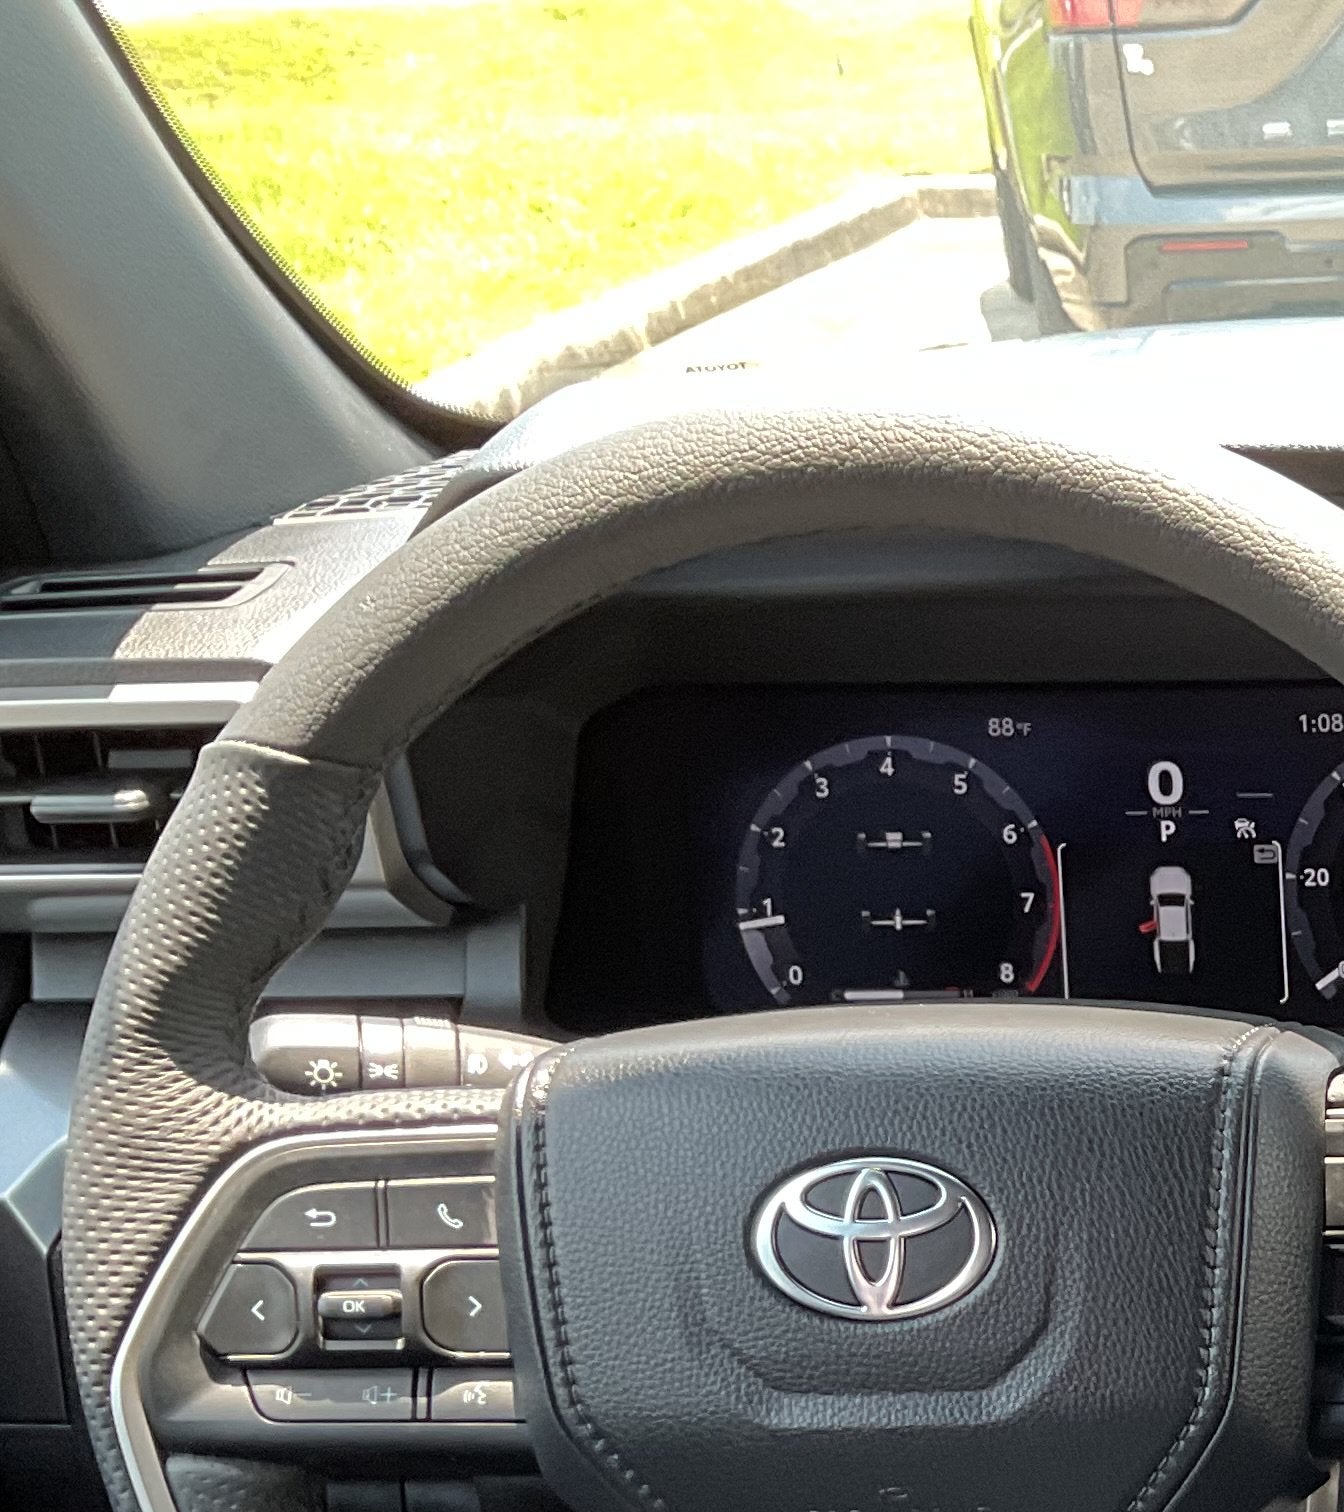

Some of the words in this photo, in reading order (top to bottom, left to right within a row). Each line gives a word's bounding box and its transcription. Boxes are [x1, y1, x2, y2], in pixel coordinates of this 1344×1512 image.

[1299, 713, 1344, 733] 1:08
[879, 756, 895, 777] 4
[815, 777, 830, 798] 3
[953, 773, 968, 795] 5
[1147, 760, 1184, 806] 0
[1152, 806, 1183, 818] MPH
[771, 827, 786, 848] 2
[1002, 823, 1017, 844] 6
[1160, 820, 1177, 842] P
[1303, 867, 1330, 887] 20
[762, 898, 773, 917] 1
[1020, 892, 1035, 913] 7
[788, 965, 803, 985] 0
[1000, 962, 1015, 983] 8
[342, 1300, 366, 1313] OK
